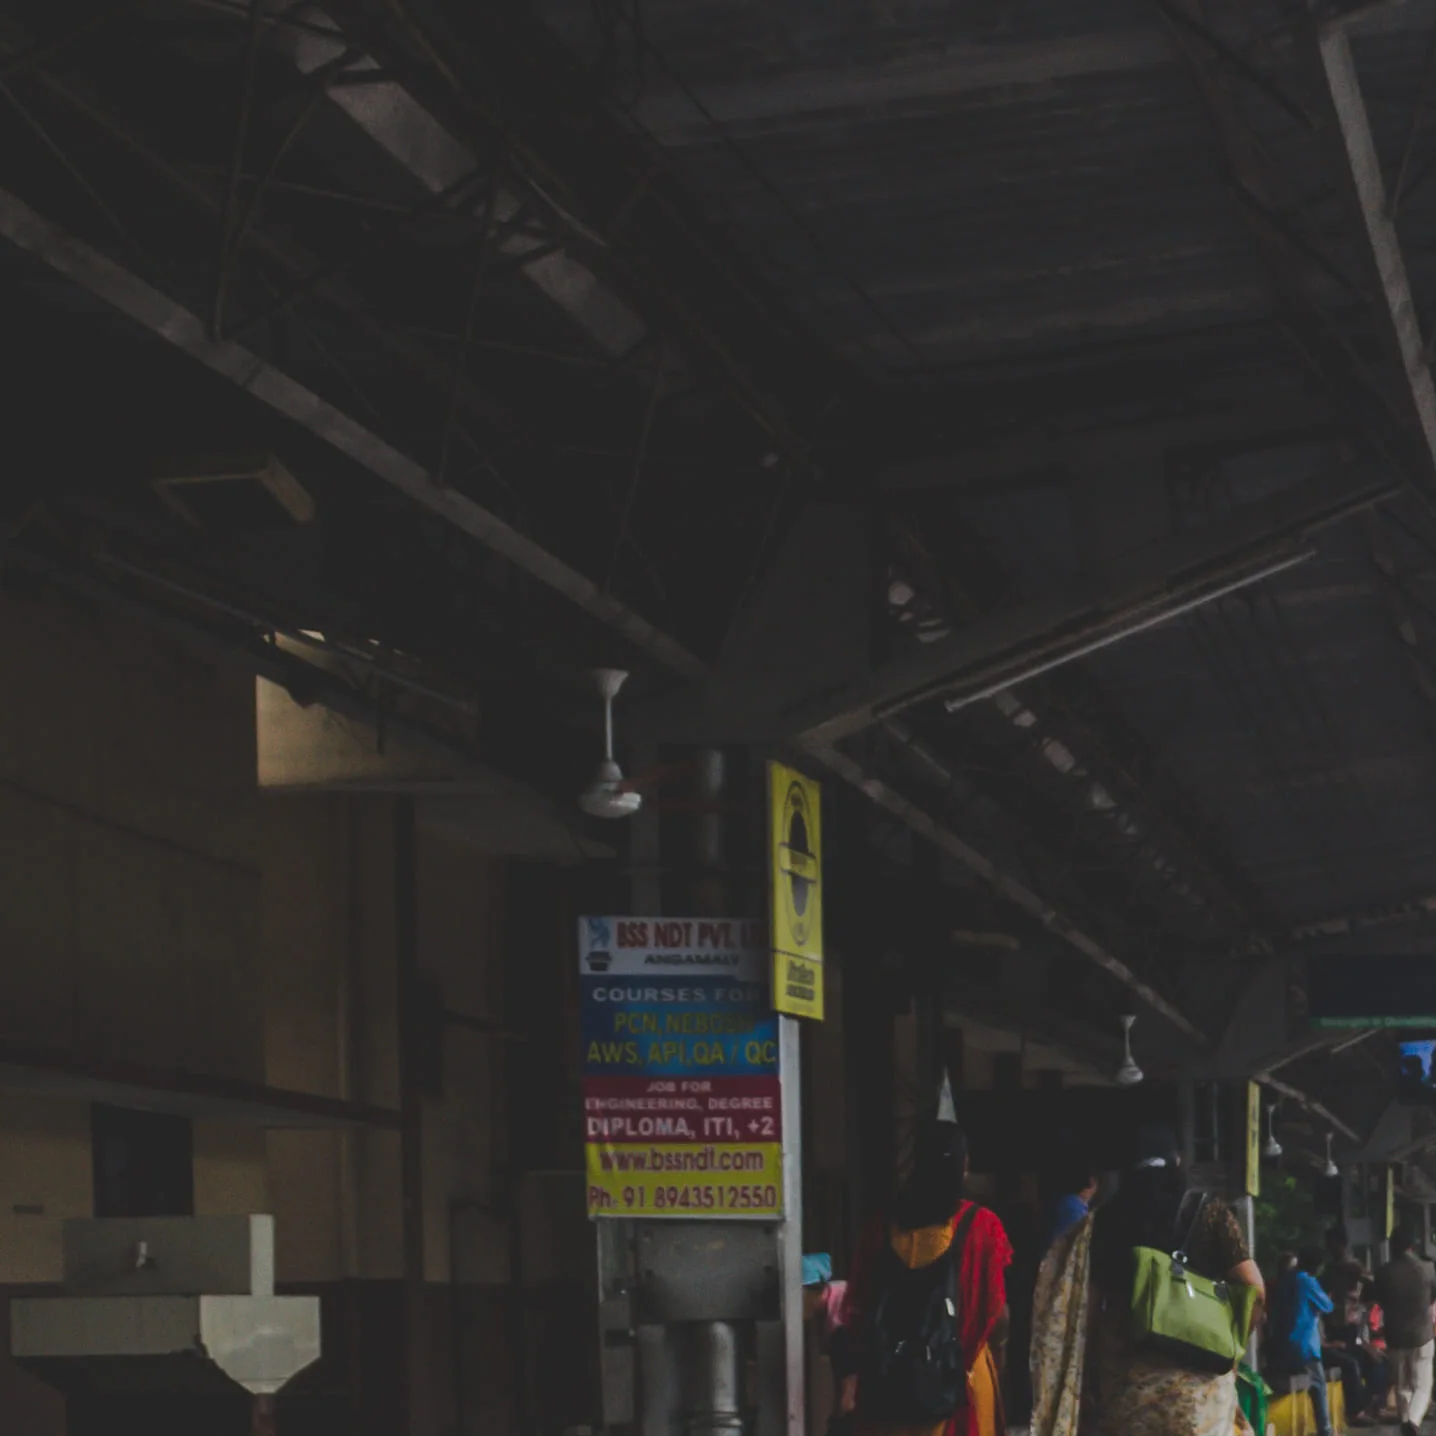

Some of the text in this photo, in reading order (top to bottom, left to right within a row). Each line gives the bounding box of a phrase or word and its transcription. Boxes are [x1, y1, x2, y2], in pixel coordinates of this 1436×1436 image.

[615, 921, 650, 949] BSS
[654, 921, 694, 949] NDT
[592, 986, 761, 1004] COURSES FOR
[744, 1040, 777, 1065] QC
[646, 1080, 713, 1094] JOB FOR
[707, 1097, 774, 1111] DEGREE
[587, 1116, 776, 1140] DIPLOMA, ITI, +2
[599, 1146, 765, 1172] www.bssndt.com
[623, 1185, 646, 1208] 91
[653, 1185, 777, 1209] 8943512550
